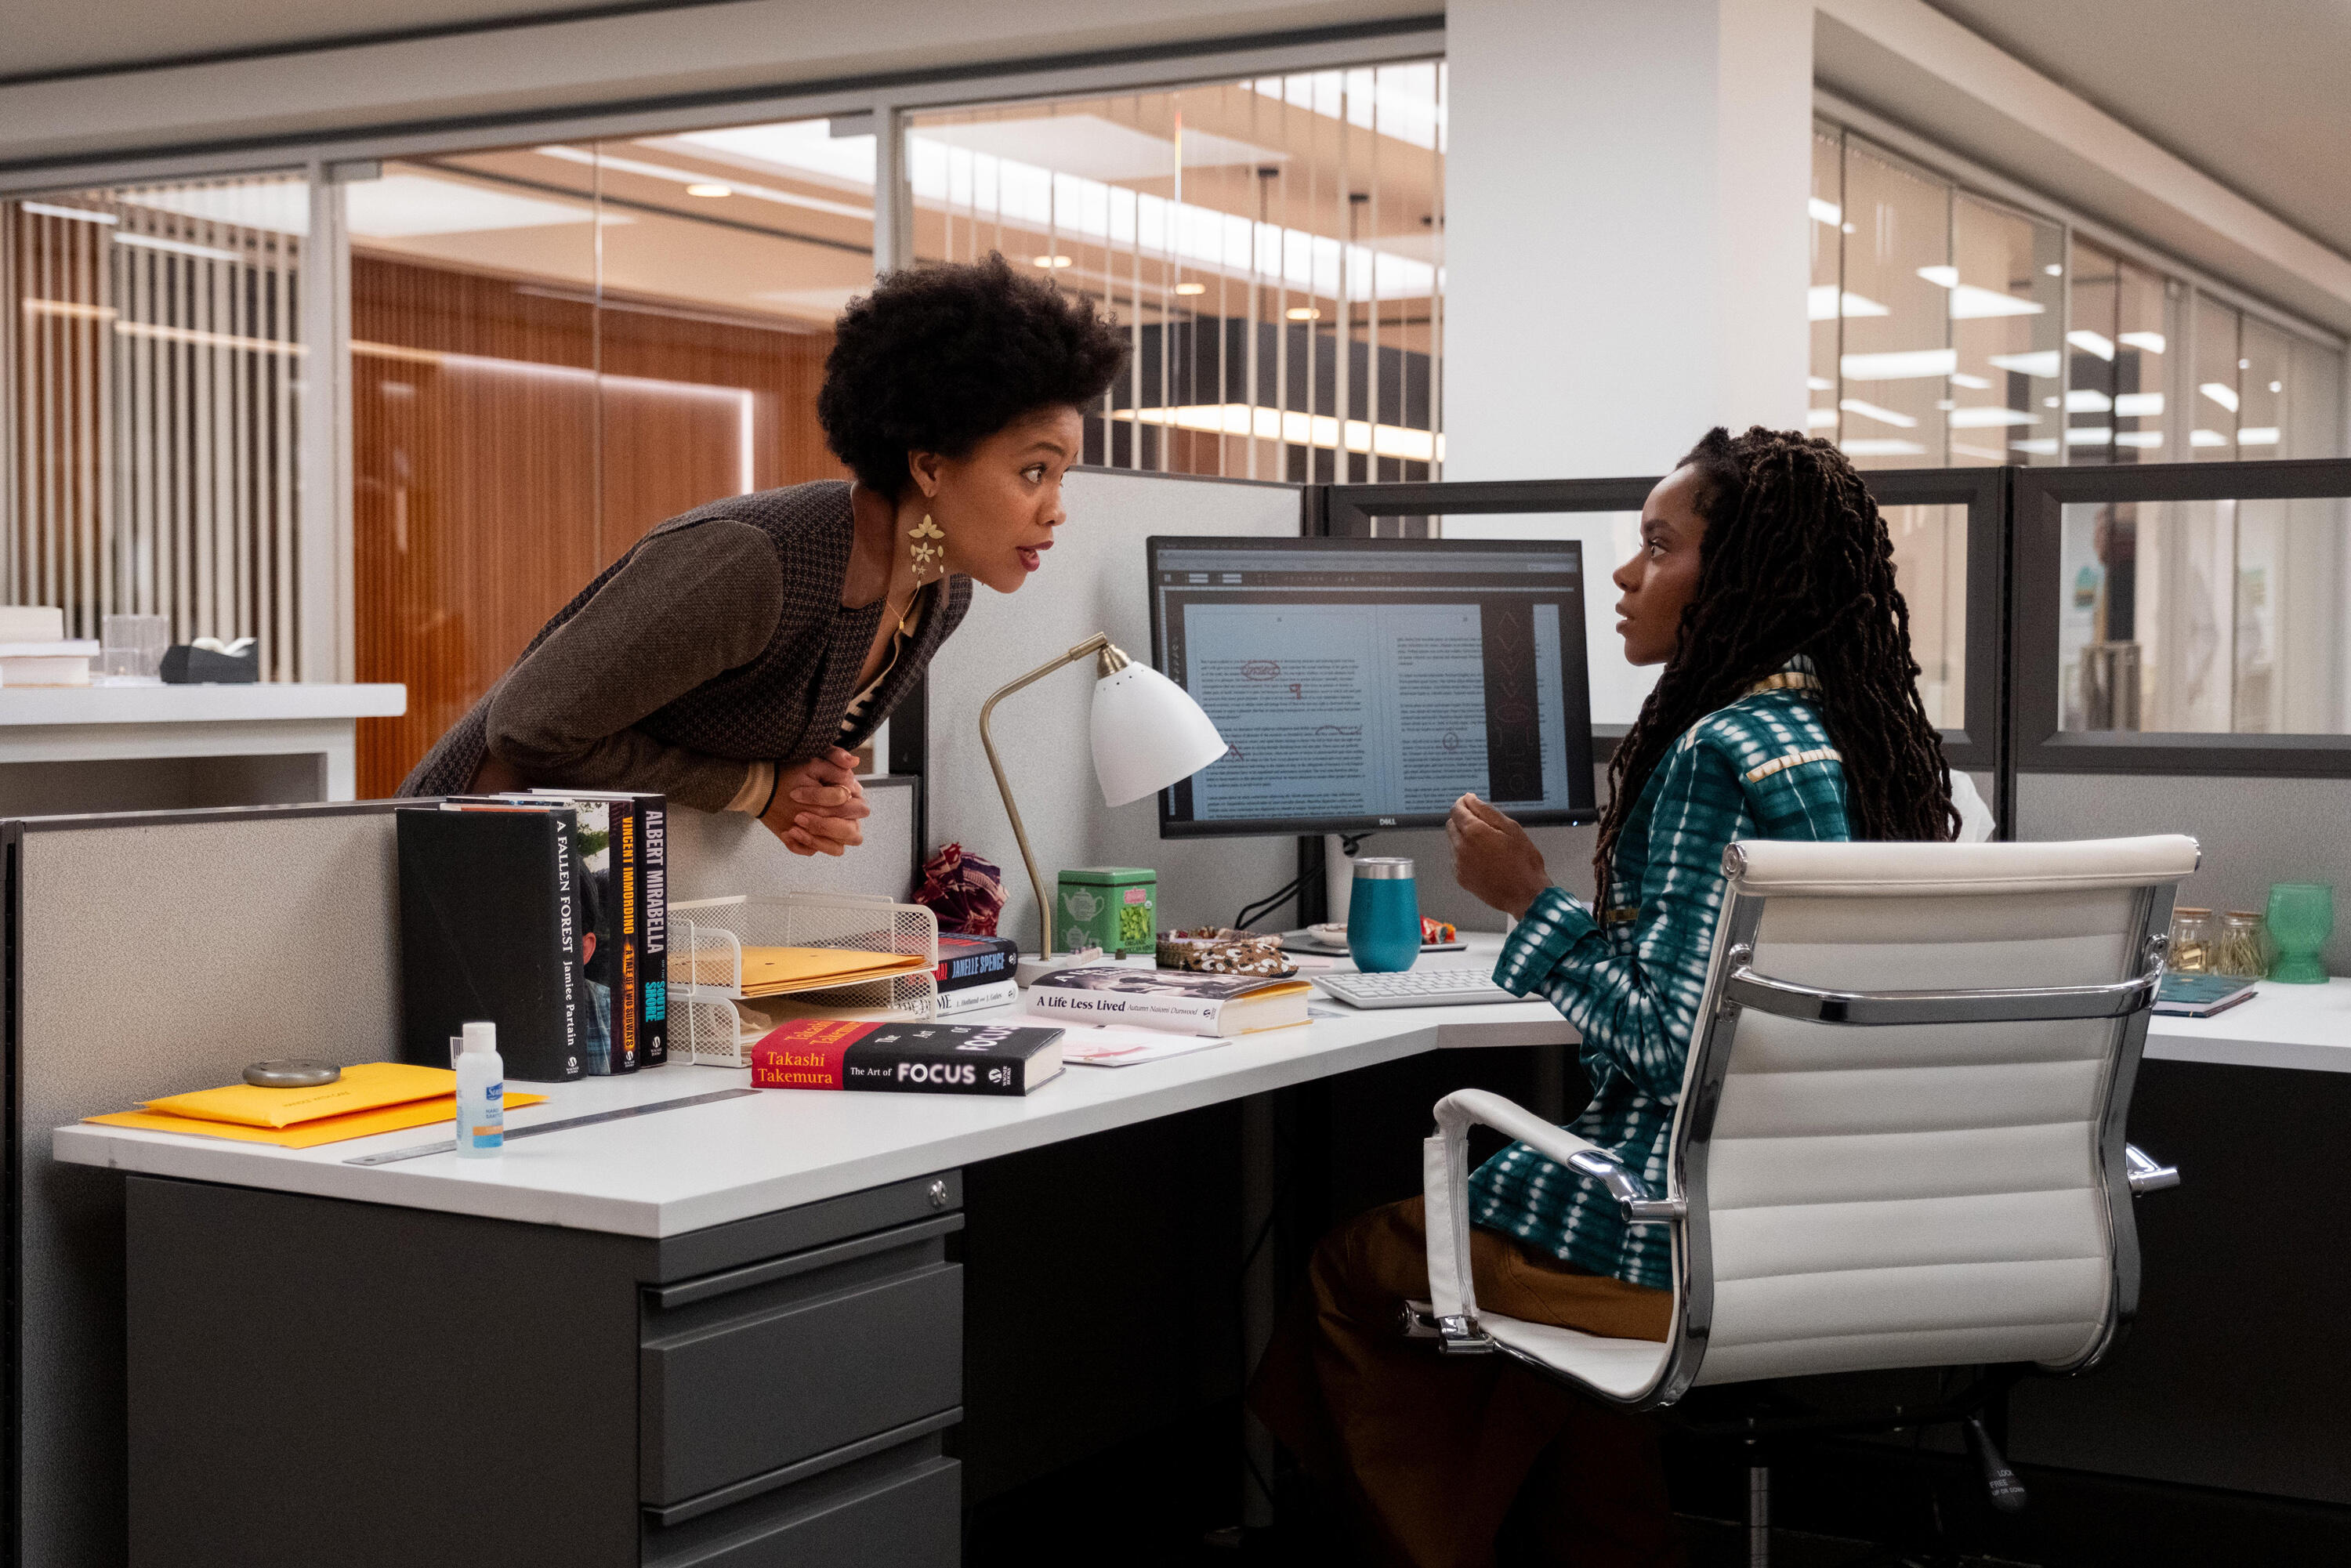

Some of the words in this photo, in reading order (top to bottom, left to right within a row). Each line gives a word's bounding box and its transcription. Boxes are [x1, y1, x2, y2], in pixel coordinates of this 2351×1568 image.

[557, 820, 567, 832] A
[622, 817, 634, 864] VINCENT
[646, 810, 664, 866] ALBERT
[557, 836, 571, 891] FALLEN
[623, 867, 634, 935] IMMORDINO
[647, 870, 665, 954] MIRABELLA
[560, 896, 574, 953] FOREST
[563, 961, 574, 1001] Jamiee
[626, 976, 633, 985] OF
[952, 957, 980, 979] JANELLE
[980, 952, 1005, 973] SPENCE
[646, 981, 657, 1022] SHORE
[657, 981, 665, 1021] SOUTH
[1037, 996, 1045, 1006] A
[1048, 997, 1067, 1008] Life
[1070, 998, 1093, 1010] Less
[1097, 1000, 1126, 1012] Lived
[566, 1004, 577, 1046] Partain
[758, 1068, 833, 1085] Takemura
[767, 1052, 824, 1066] Takashi
[867, 1067, 880, 1076] Art
[897, 1063, 976, 1084] FOCUS
